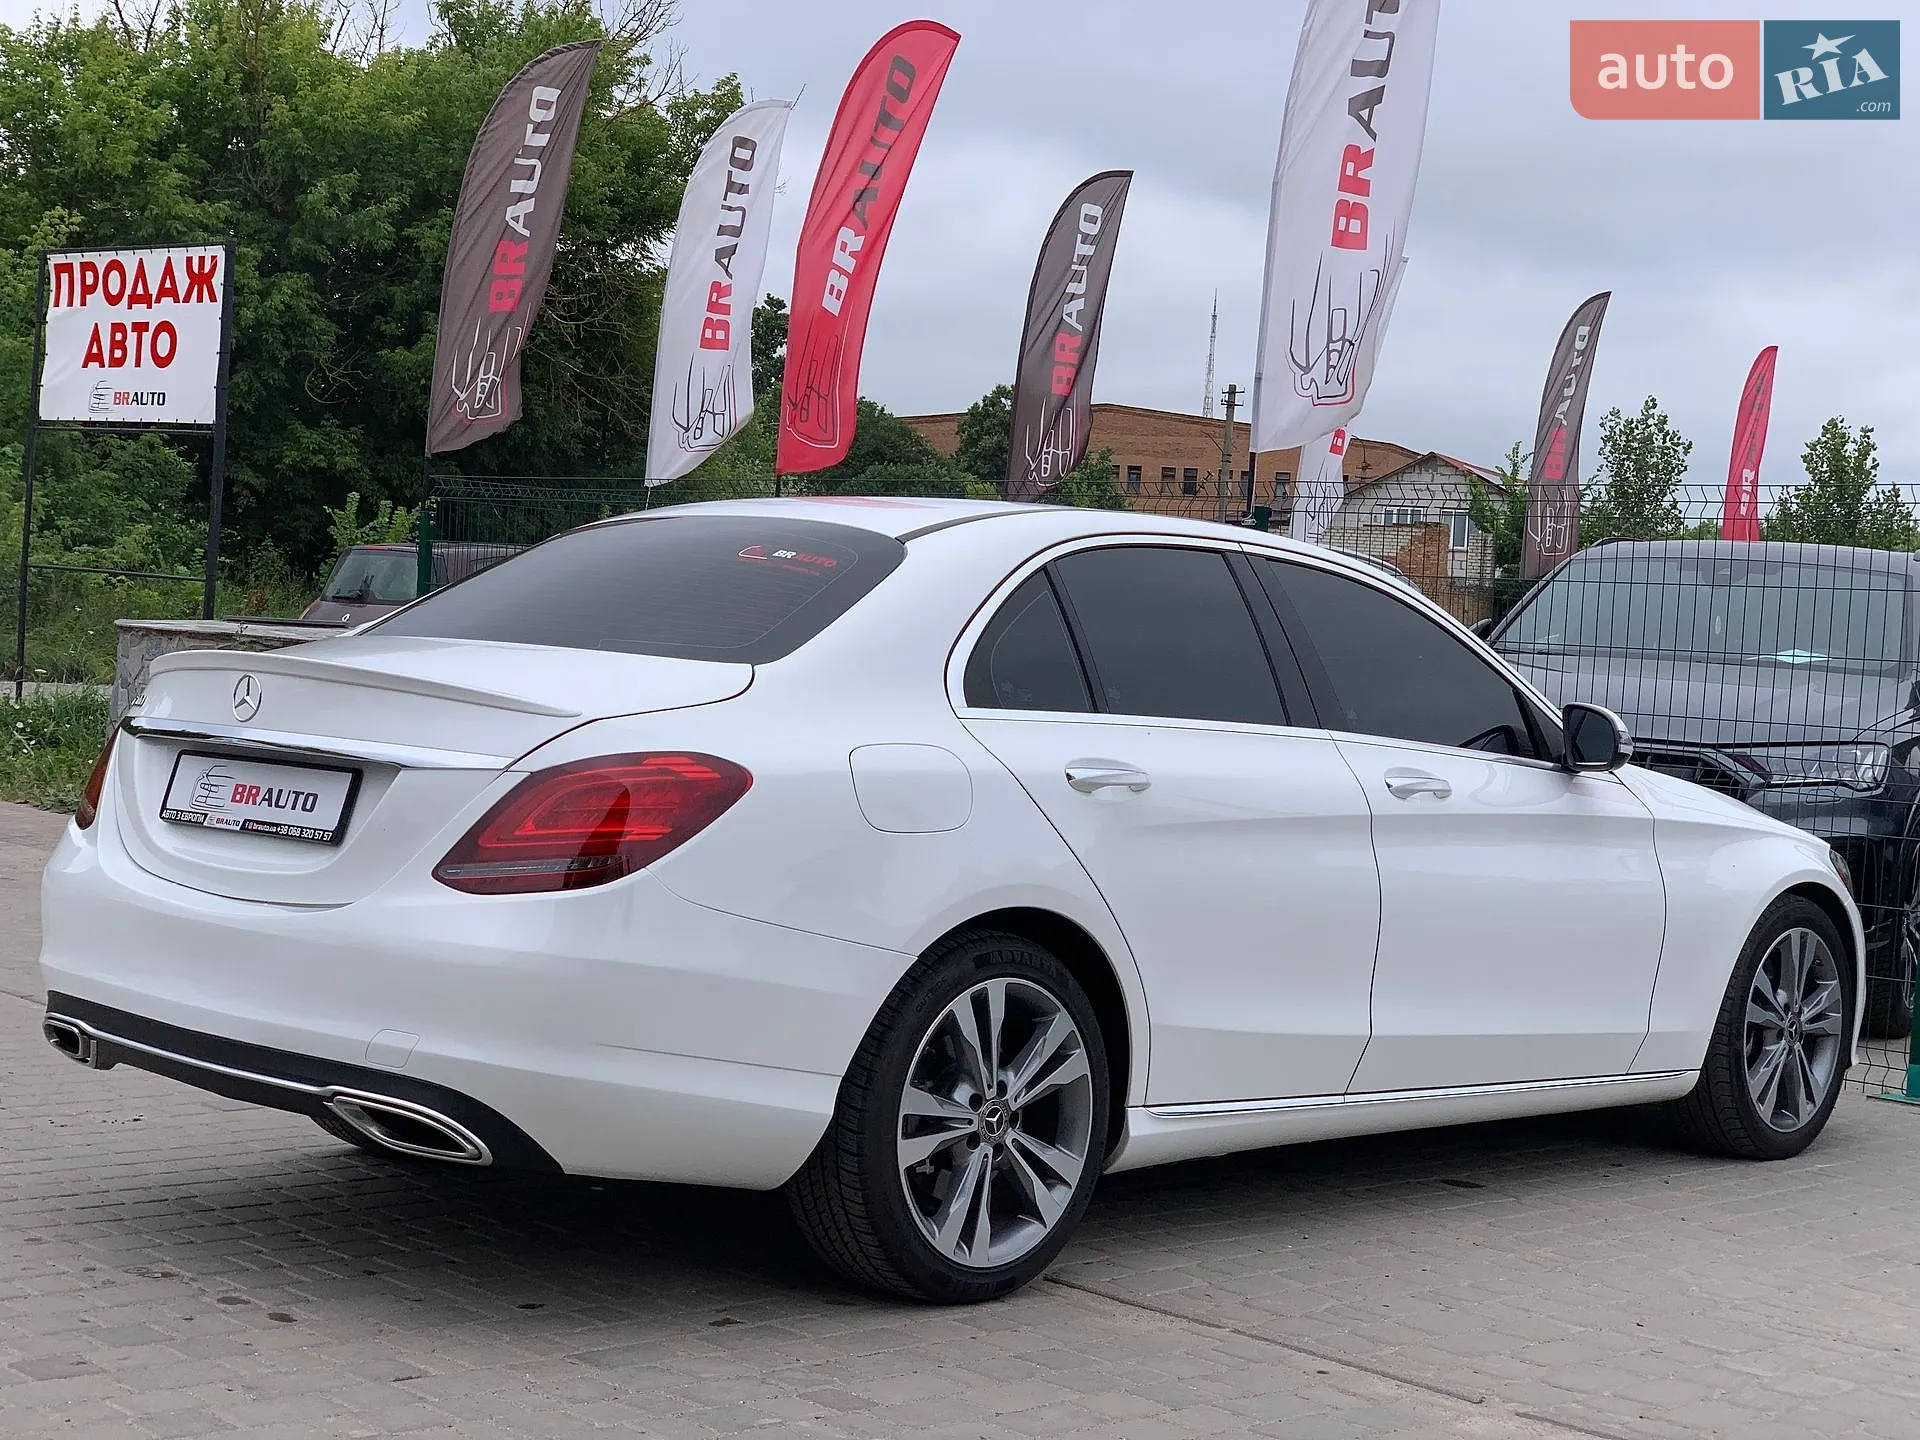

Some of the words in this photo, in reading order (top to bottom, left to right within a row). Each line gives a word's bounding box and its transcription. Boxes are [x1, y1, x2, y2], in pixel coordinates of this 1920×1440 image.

[488, 85, 562, 313] BRAUTO
[821, 54, 918, 317] BRAUTO
[698, 135, 758, 351] BRAUTO
[52, 255, 219, 311] ПРОДАЖ
[1050, 202, 1104, 397] BRAUTO
[81, 320, 178, 369] АВТО
[112, 391, 167, 406] BRAUTO
[161, 809, 177, 819] АВТО
[215, 817, 241, 827] BRAUTO
[230, 783, 319, 813] BRAUTO
[301, 829, 314, 838] 320
[314, 830, 323, 840] 57
[323, 832, 333, 841] 57
